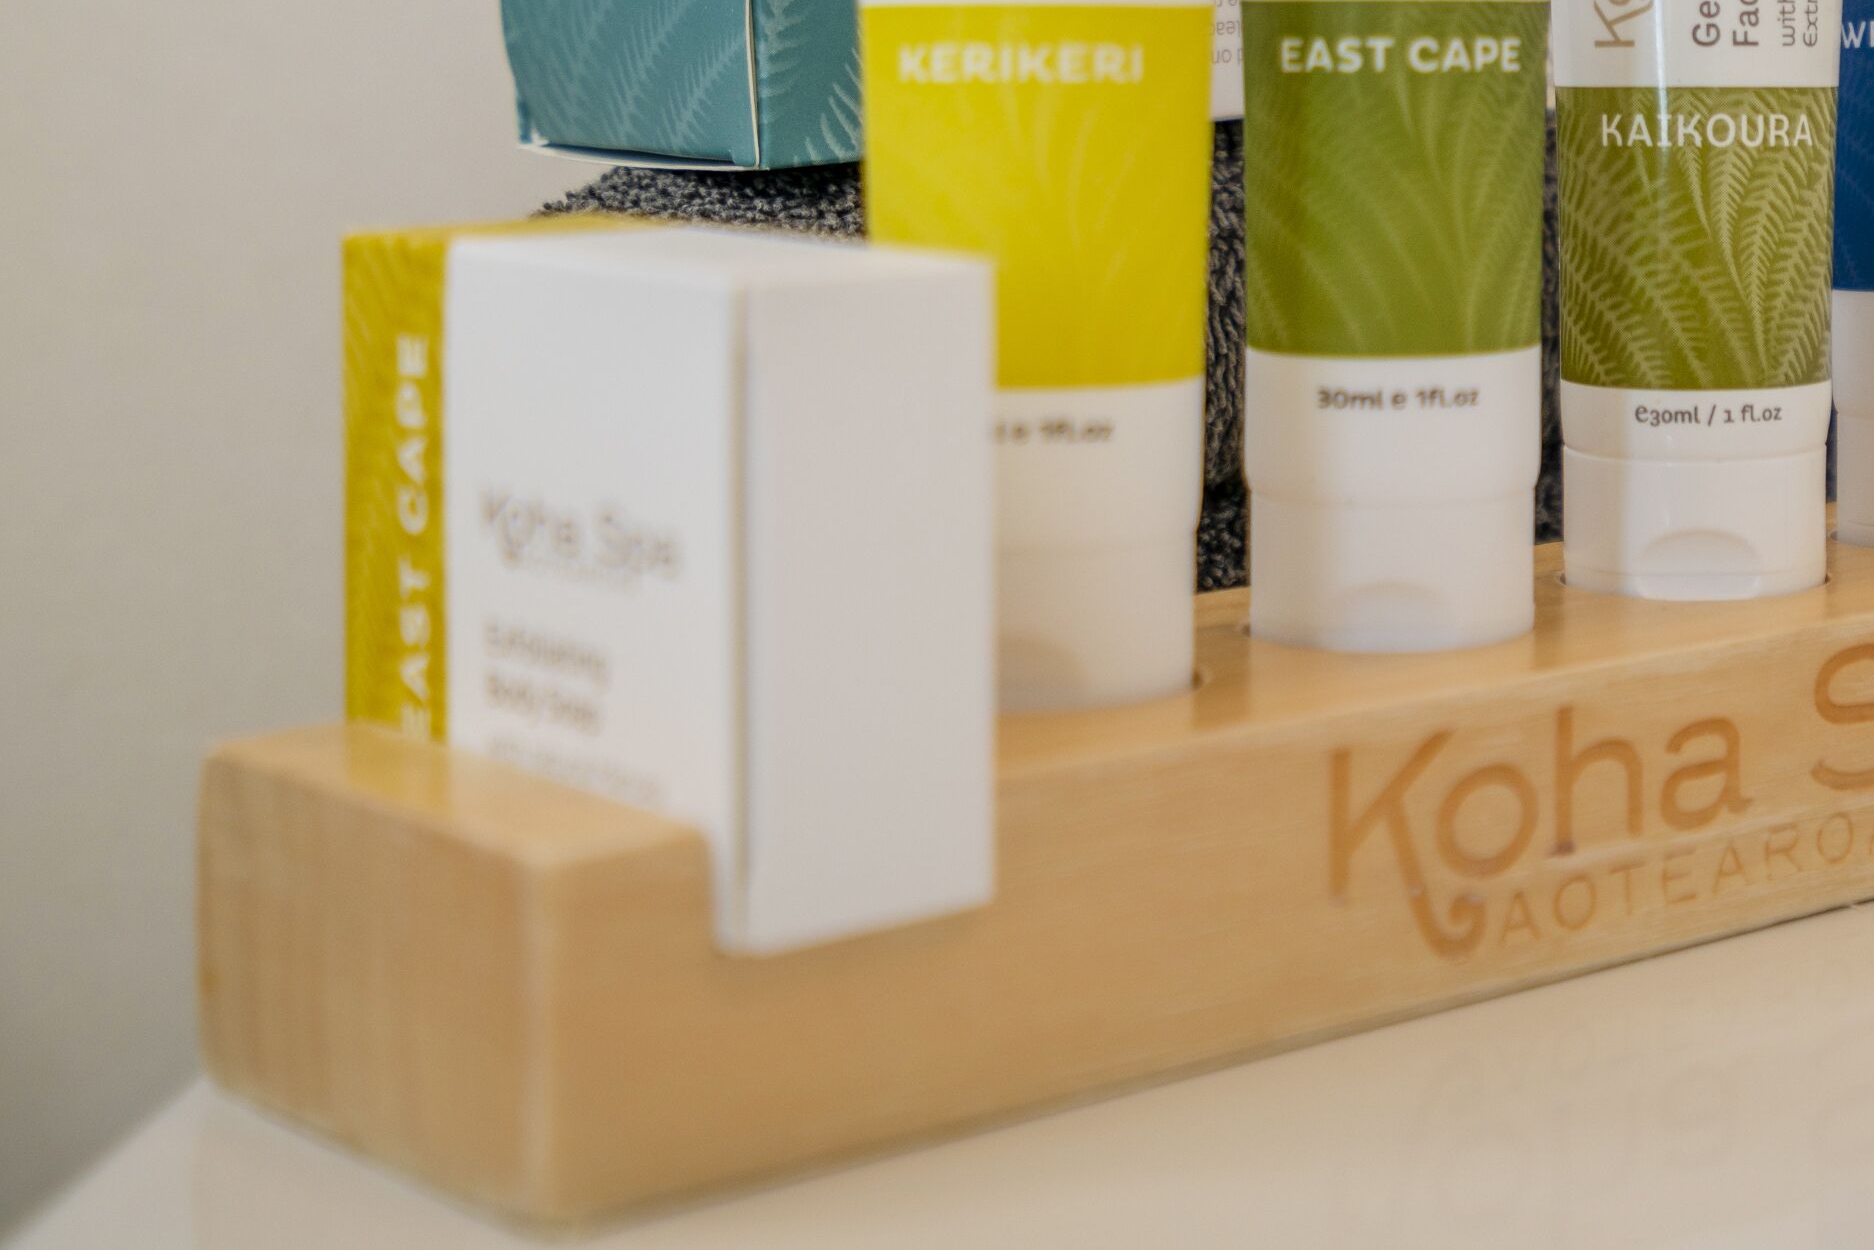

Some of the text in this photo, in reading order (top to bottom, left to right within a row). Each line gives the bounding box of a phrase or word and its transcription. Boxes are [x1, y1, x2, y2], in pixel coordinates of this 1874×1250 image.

[898, 42, 1144, 85] KERIKERI
[1280, 37, 1393, 74] EAST
[1408, 36, 1521, 73] CAPE
[1601, 112, 1814, 148] KAIKOURA
[1317, 385, 1384, 410] 30ml
[397, 334, 431, 536] CAPE
[1327, 705, 1752, 961] Koha
